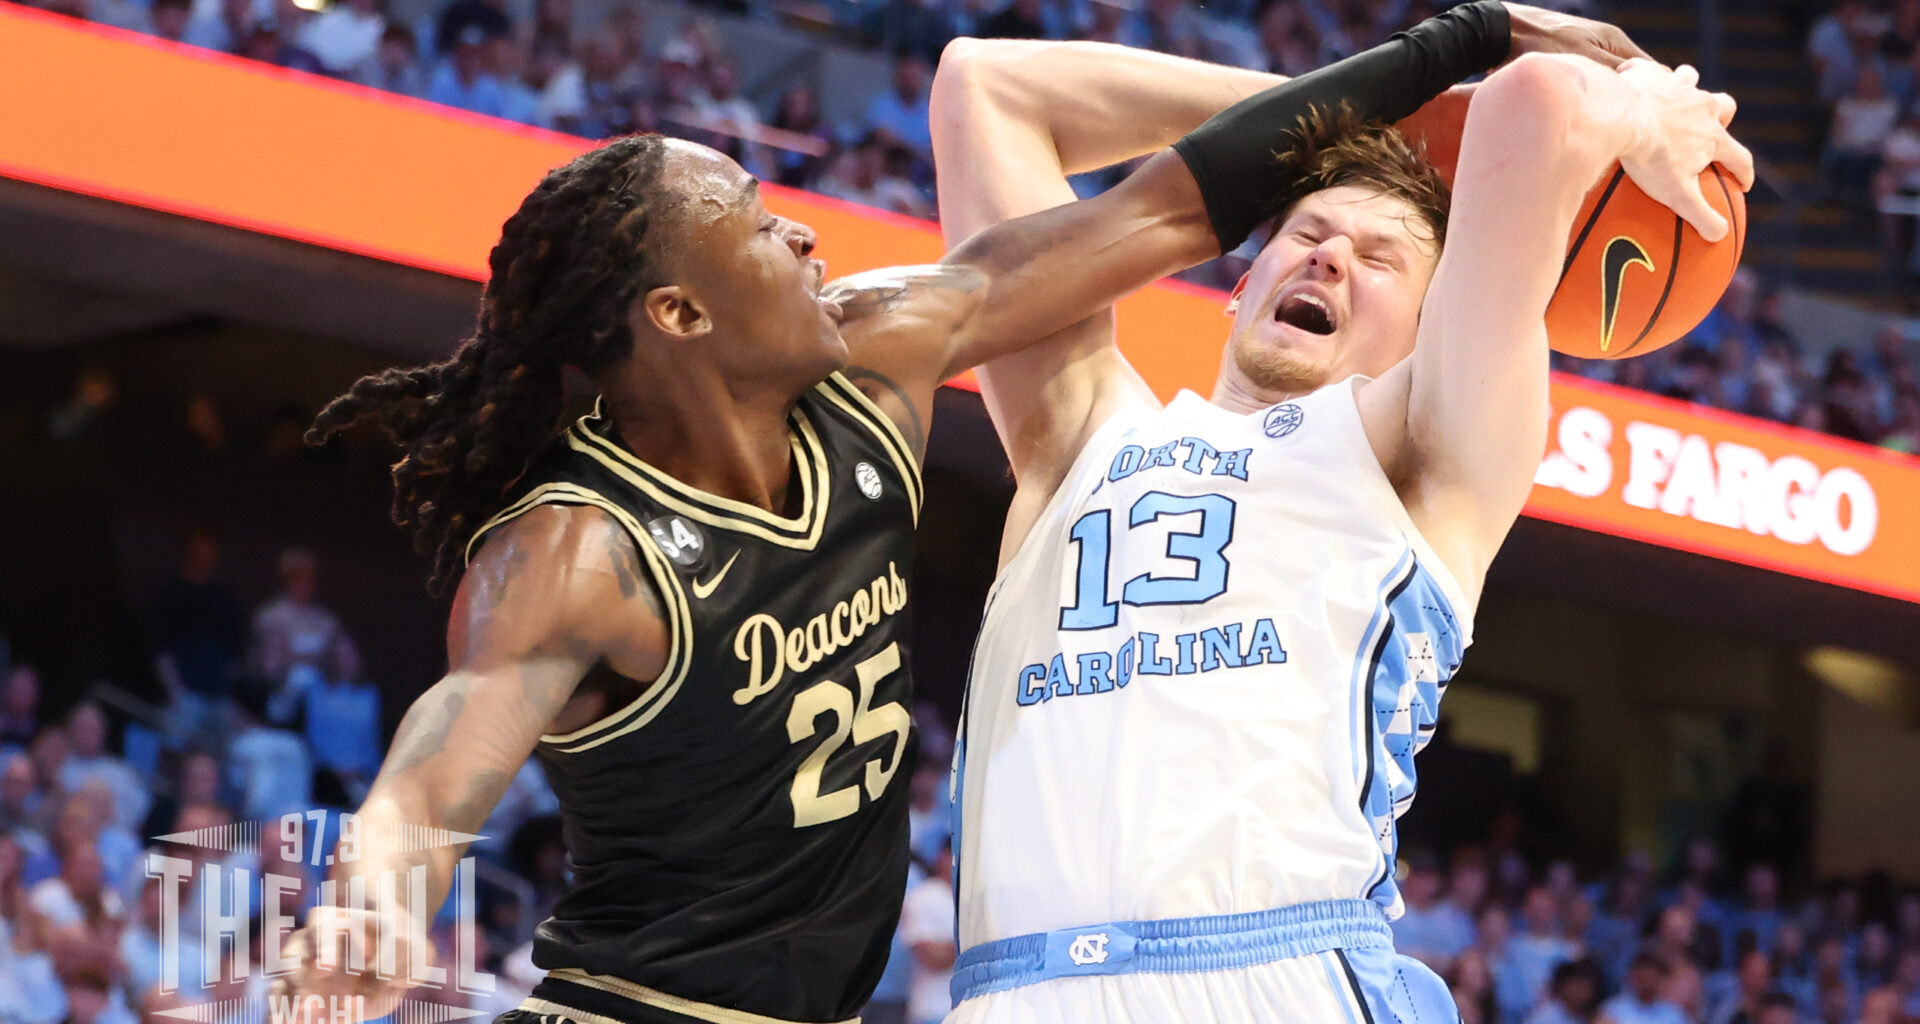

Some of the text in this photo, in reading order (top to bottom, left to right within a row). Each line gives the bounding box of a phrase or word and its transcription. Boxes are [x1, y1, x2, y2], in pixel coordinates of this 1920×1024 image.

[1622, 420, 1878, 556] FARGO
[1058, 490, 1236, 631] 13
[732, 561, 908, 706] Deacons
[1016, 618, 1287, 707] CAROLINA
[786, 641, 911, 828] 25
